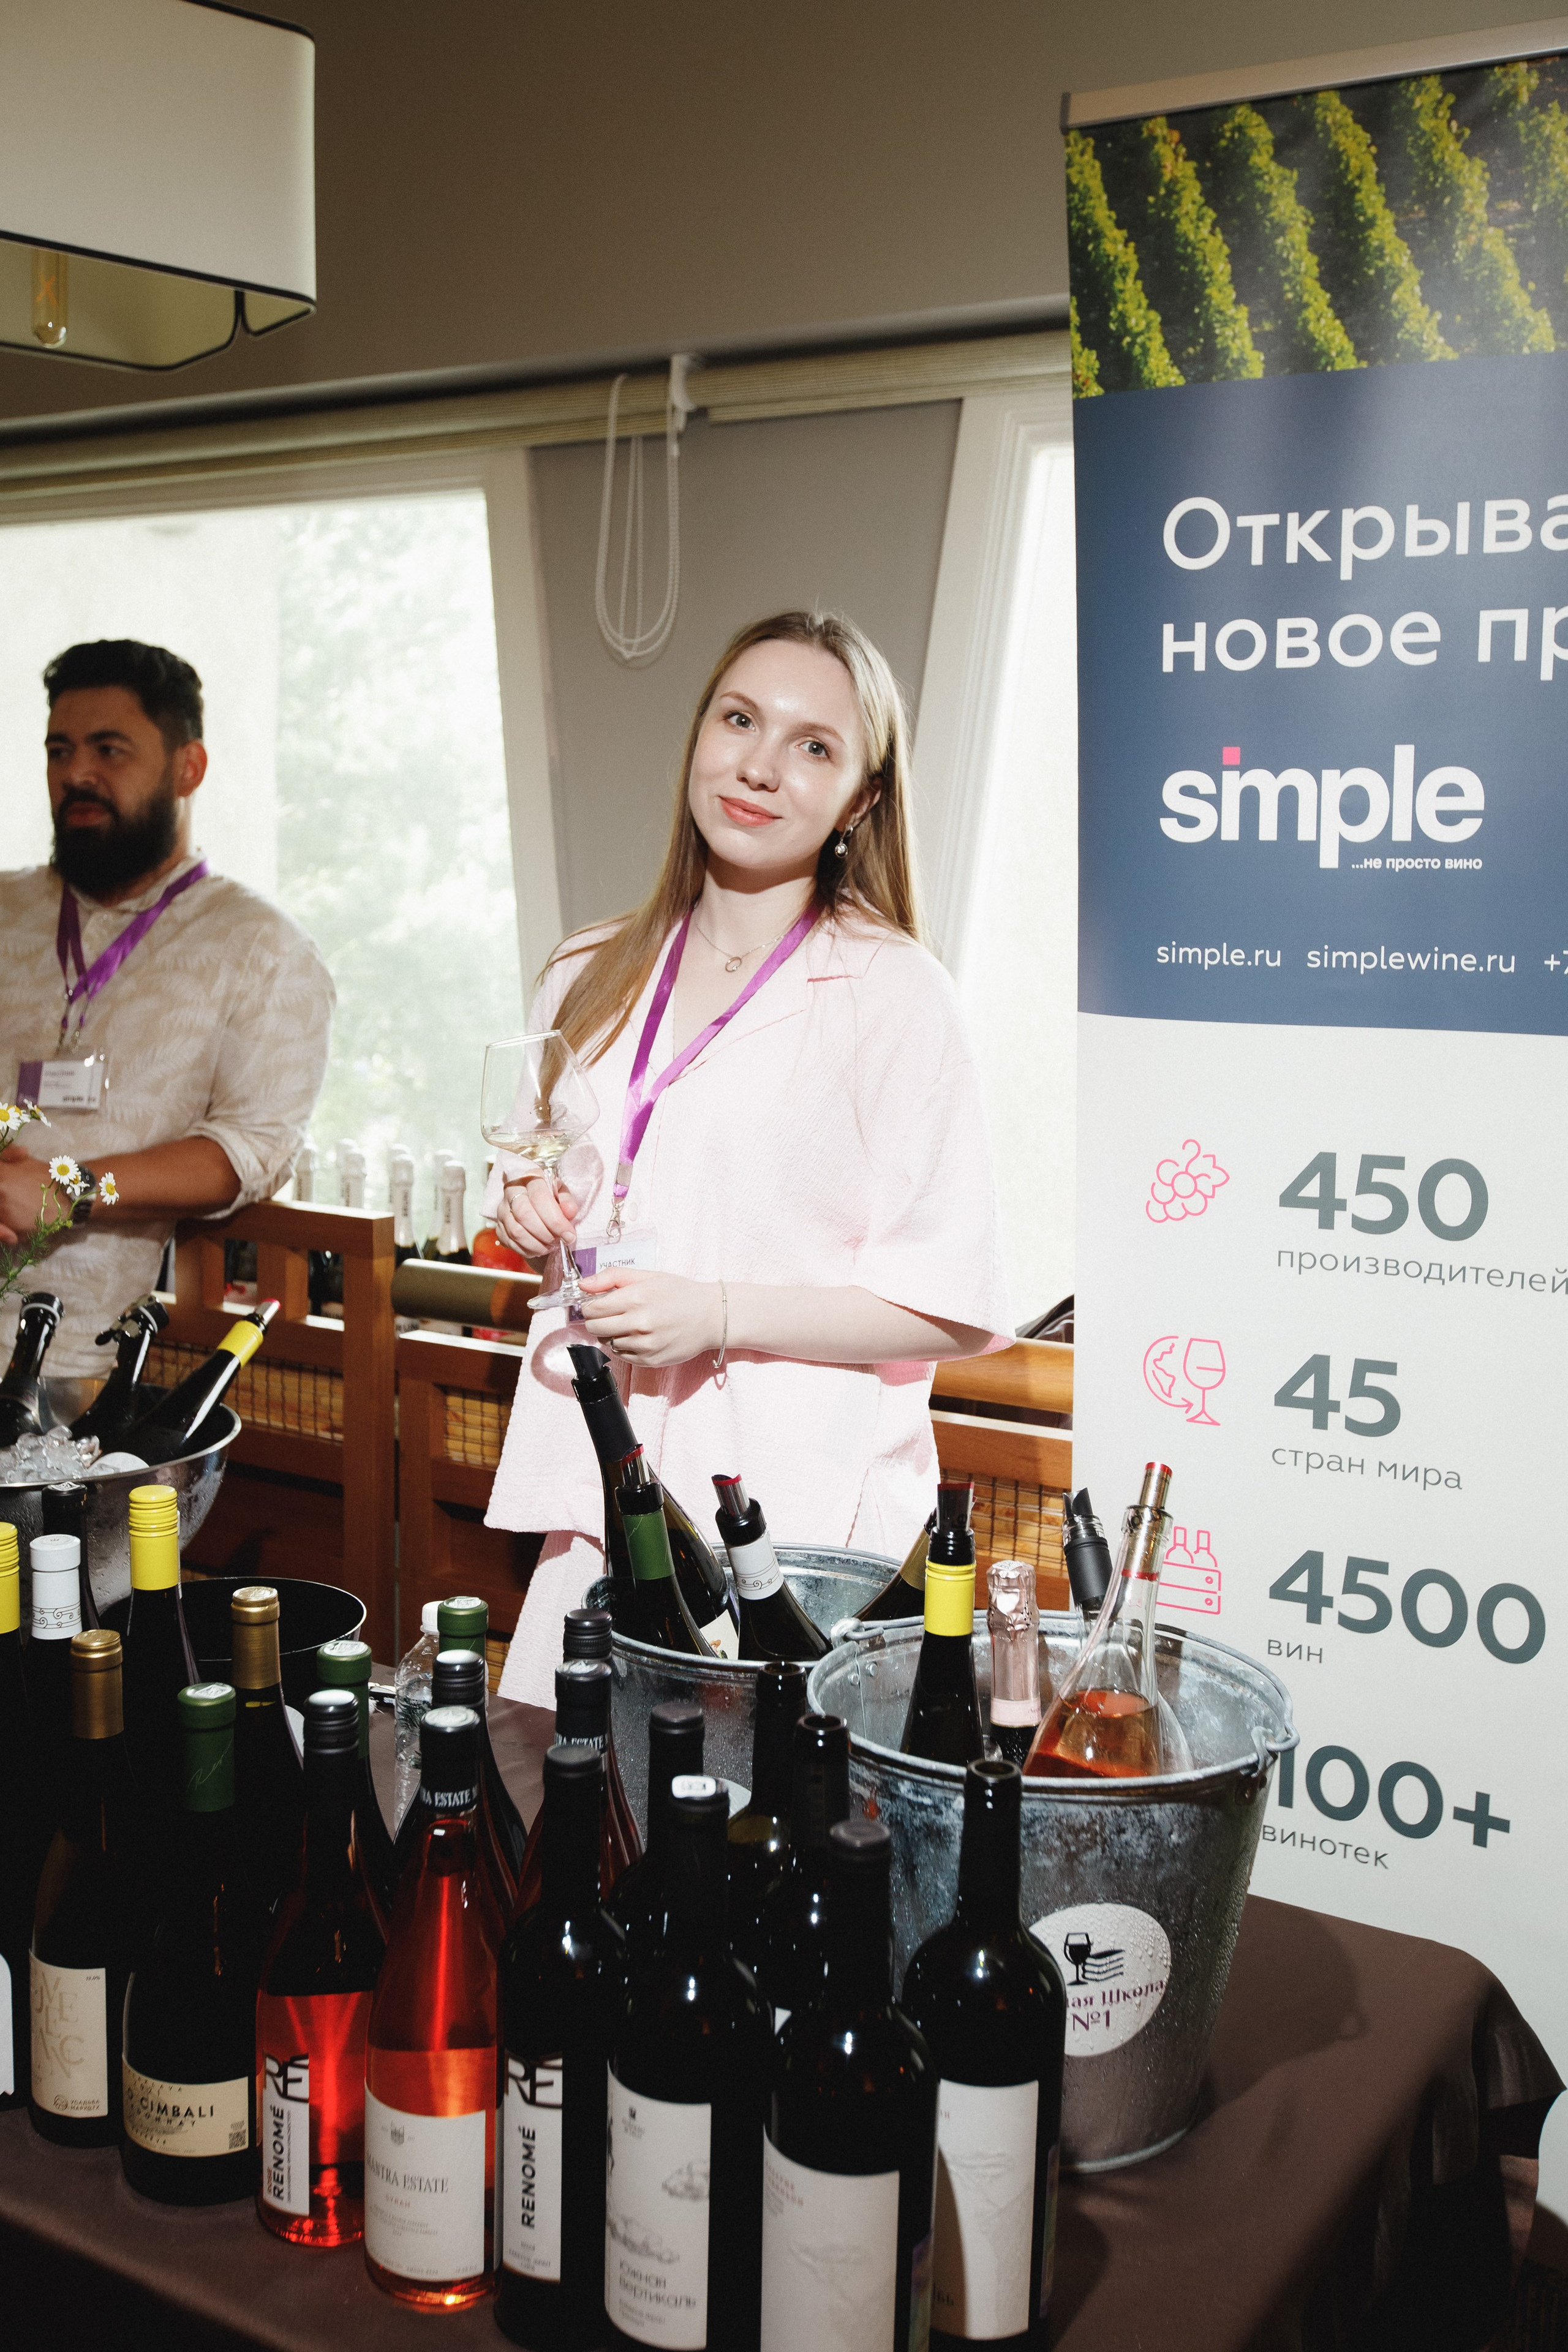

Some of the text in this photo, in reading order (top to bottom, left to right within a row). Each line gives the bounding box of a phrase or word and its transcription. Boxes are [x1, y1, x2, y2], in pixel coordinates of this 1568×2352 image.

[1163, 611, 1441, 673] новое
[1159, 744, 1485, 869] simple
[1385, 858, 1441, 872] просто
[1444, 858, 1483, 870] вино
[1156, 941, 1281, 971] simple.ru
[1306, 944, 1515, 975] simplewine.ru
[1279, 1152, 1489, 1242] 450
[600, 1258, 635, 1269] УЧАСТНИК
[1277, 1250, 1568, 1295] производителей
[1274, 1354, 1401, 1438] 45
[1272, 1448, 1463, 1491] стран мира
[1268, 1550, 1546, 1665] 4500
[1267, 1639, 1323, 1664] вин
[434, 1788, 471, 1807] ESTATE
[1278, 1745, 1510, 1849] 100+
[1262, 1825, 1389, 1869] винотек
[1102, 1980, 1164, 2006] Школа
[140, 2097, 214, 2119] CIMBALI
[270, 2104, 284, 2201] RENOMÉ
[403, 2174, 448, 2194] ESTATE
[518, 2125, 536, 2229] RENOMÉ
